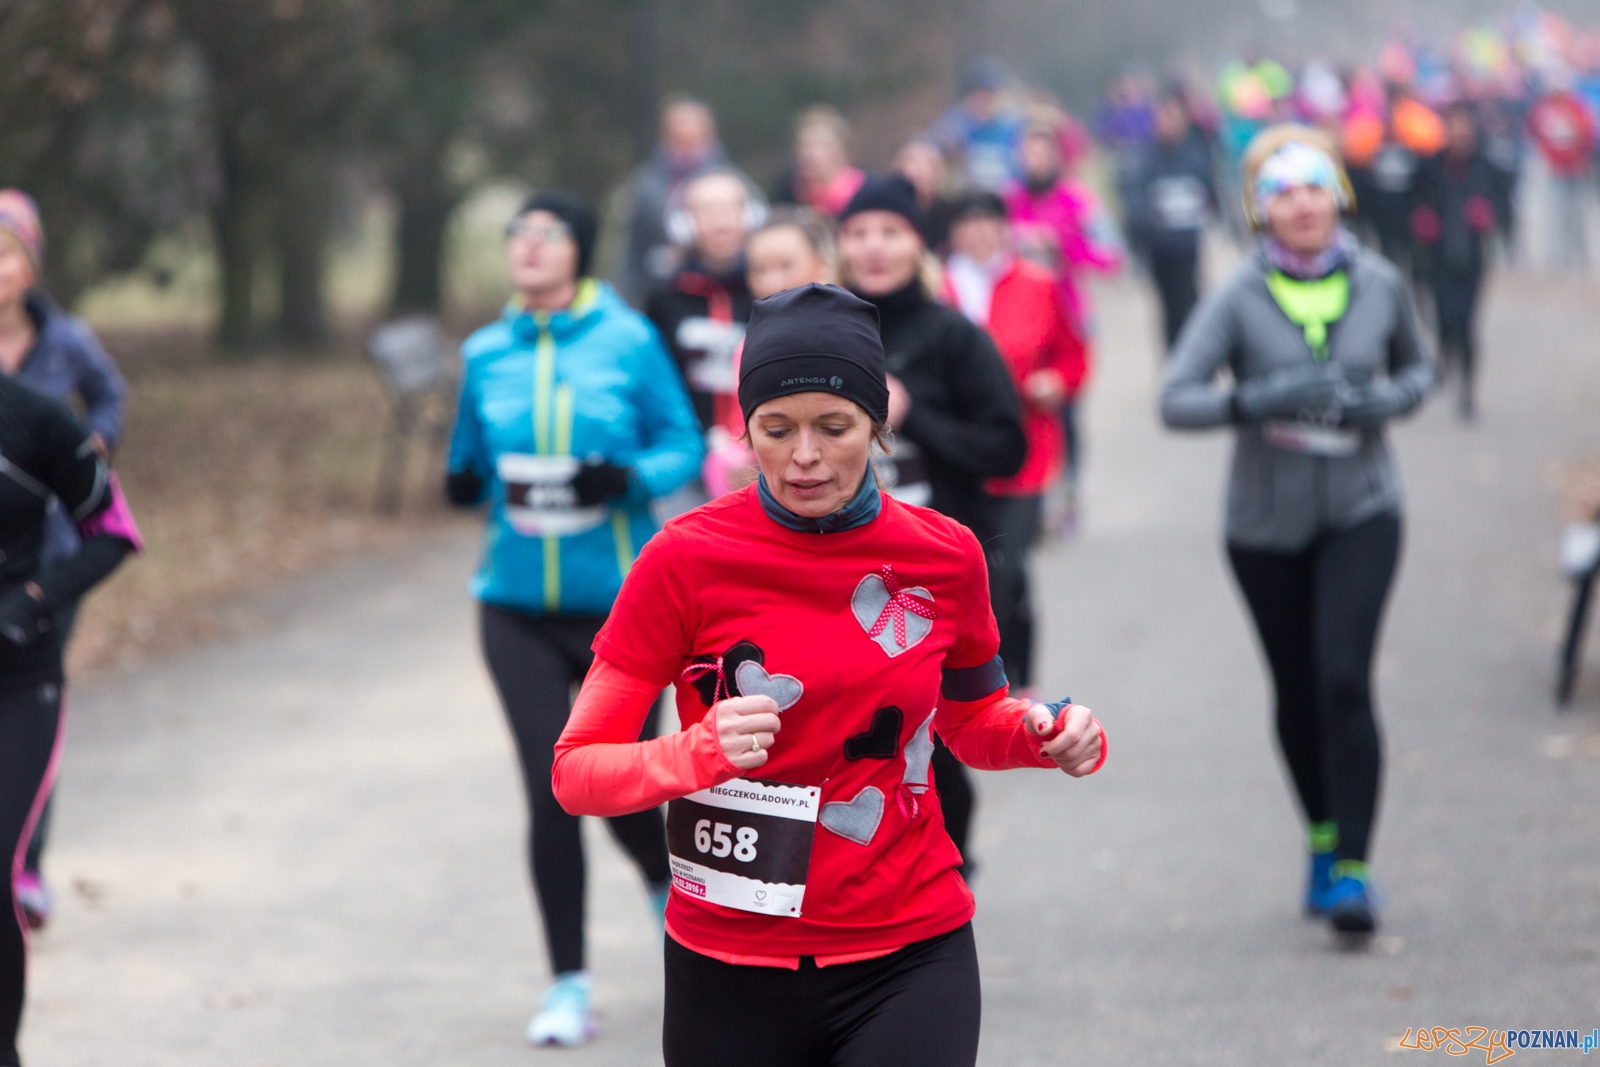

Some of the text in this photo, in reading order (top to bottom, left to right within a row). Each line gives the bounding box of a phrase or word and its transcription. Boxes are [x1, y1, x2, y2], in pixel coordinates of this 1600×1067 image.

[780, 377, 827, 387] ARTENGO
[709, 786, 810, 808] BIEGCZEKOLADOWY.PL
[694, 819, 759, 863] 658
